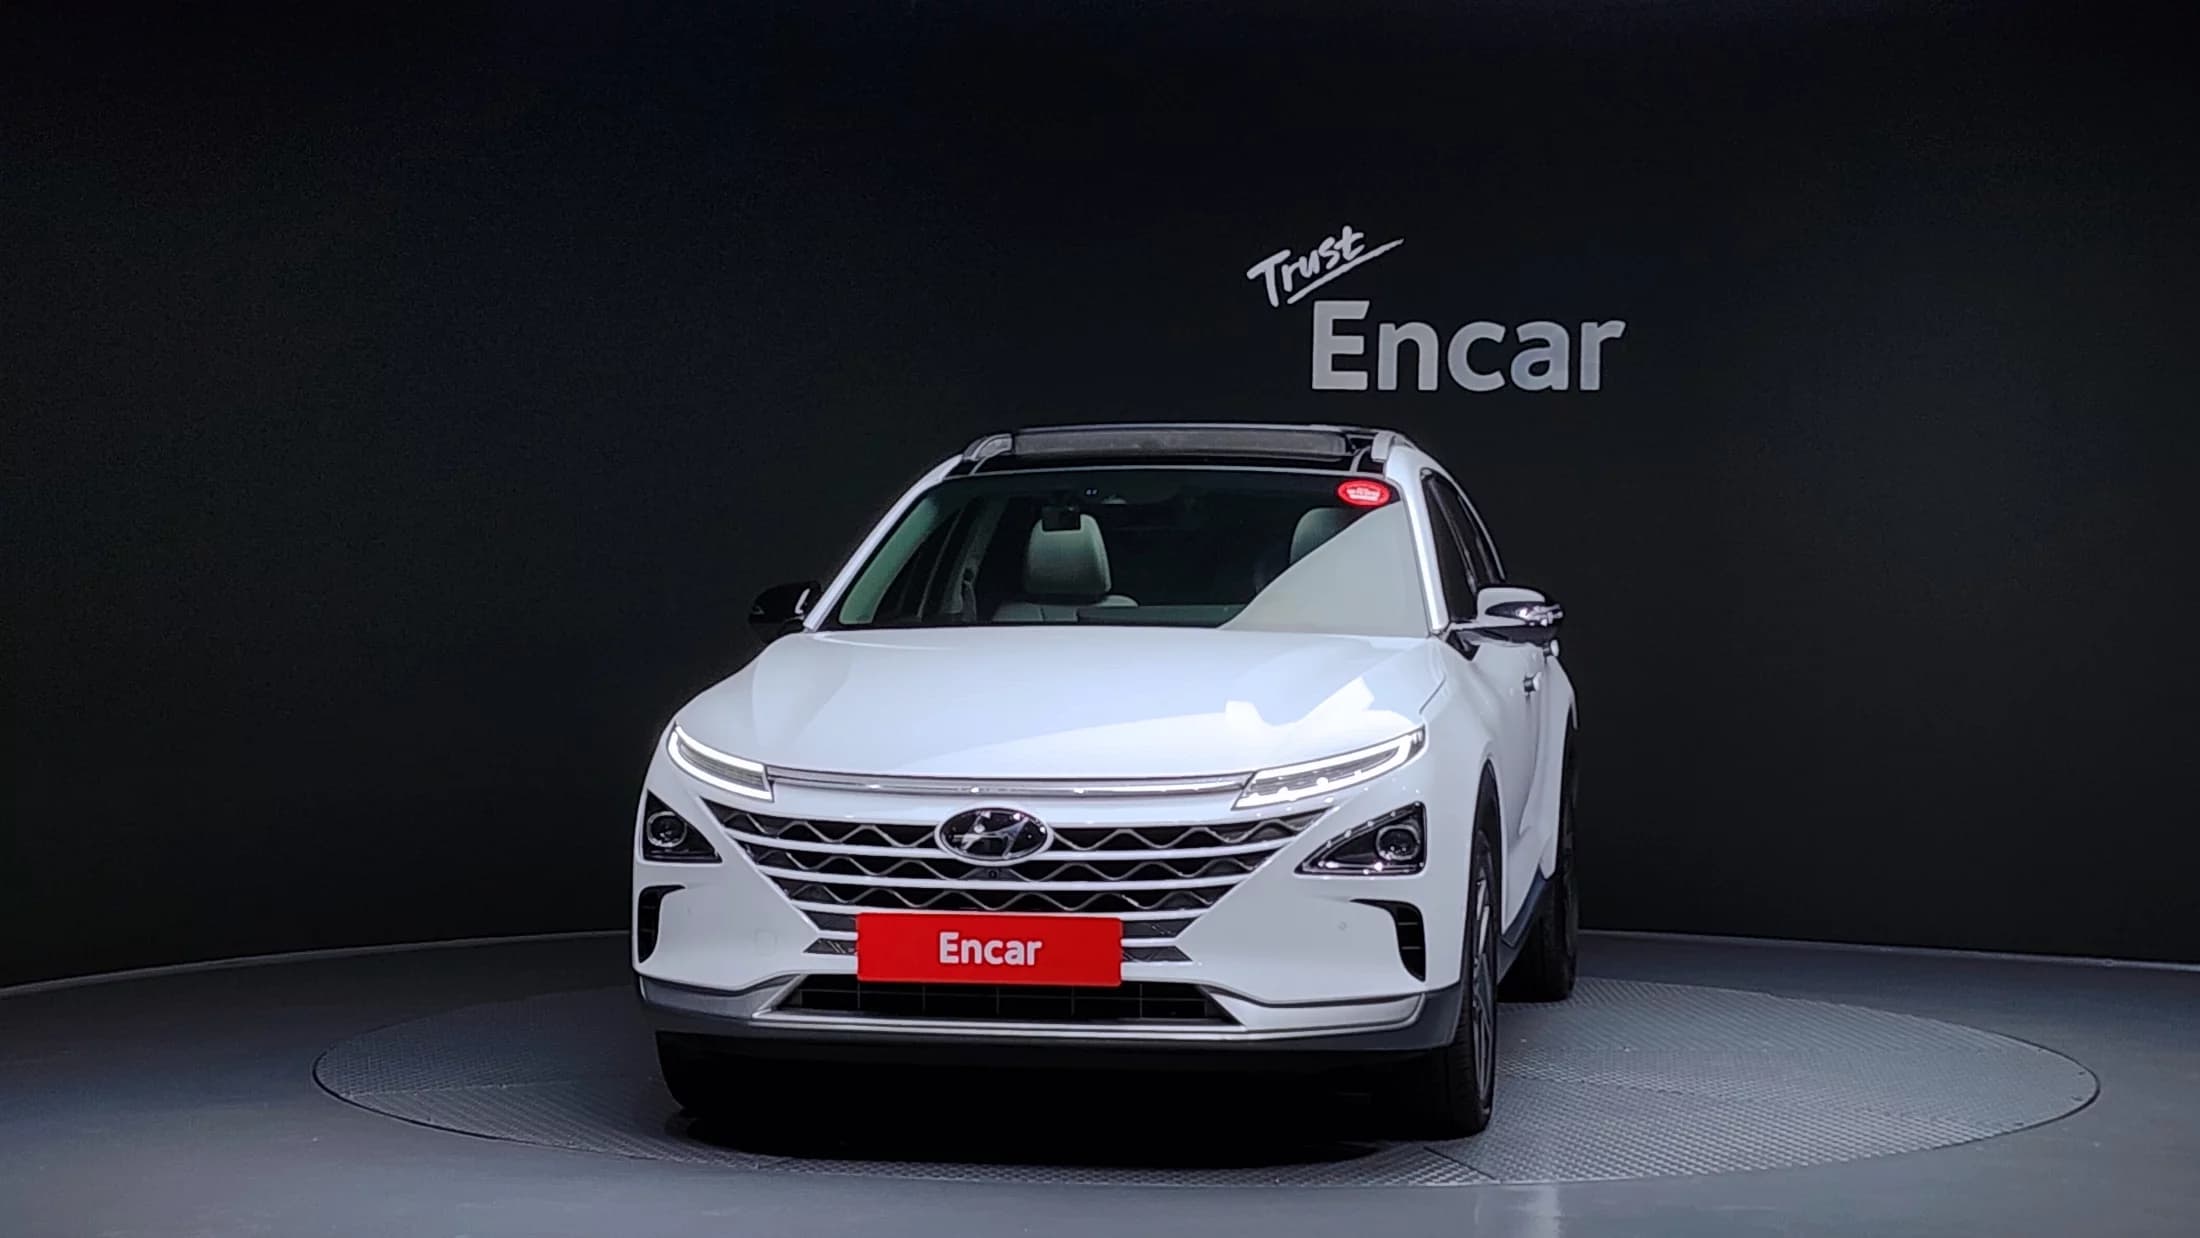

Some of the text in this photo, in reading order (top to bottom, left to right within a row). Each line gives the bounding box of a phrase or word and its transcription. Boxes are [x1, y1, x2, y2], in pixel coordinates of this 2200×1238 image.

[1246, 225, 1366, 308] Trust
[1311, 300, 1626, 392] Encar
[938, 932, 1042, 966] Encar
